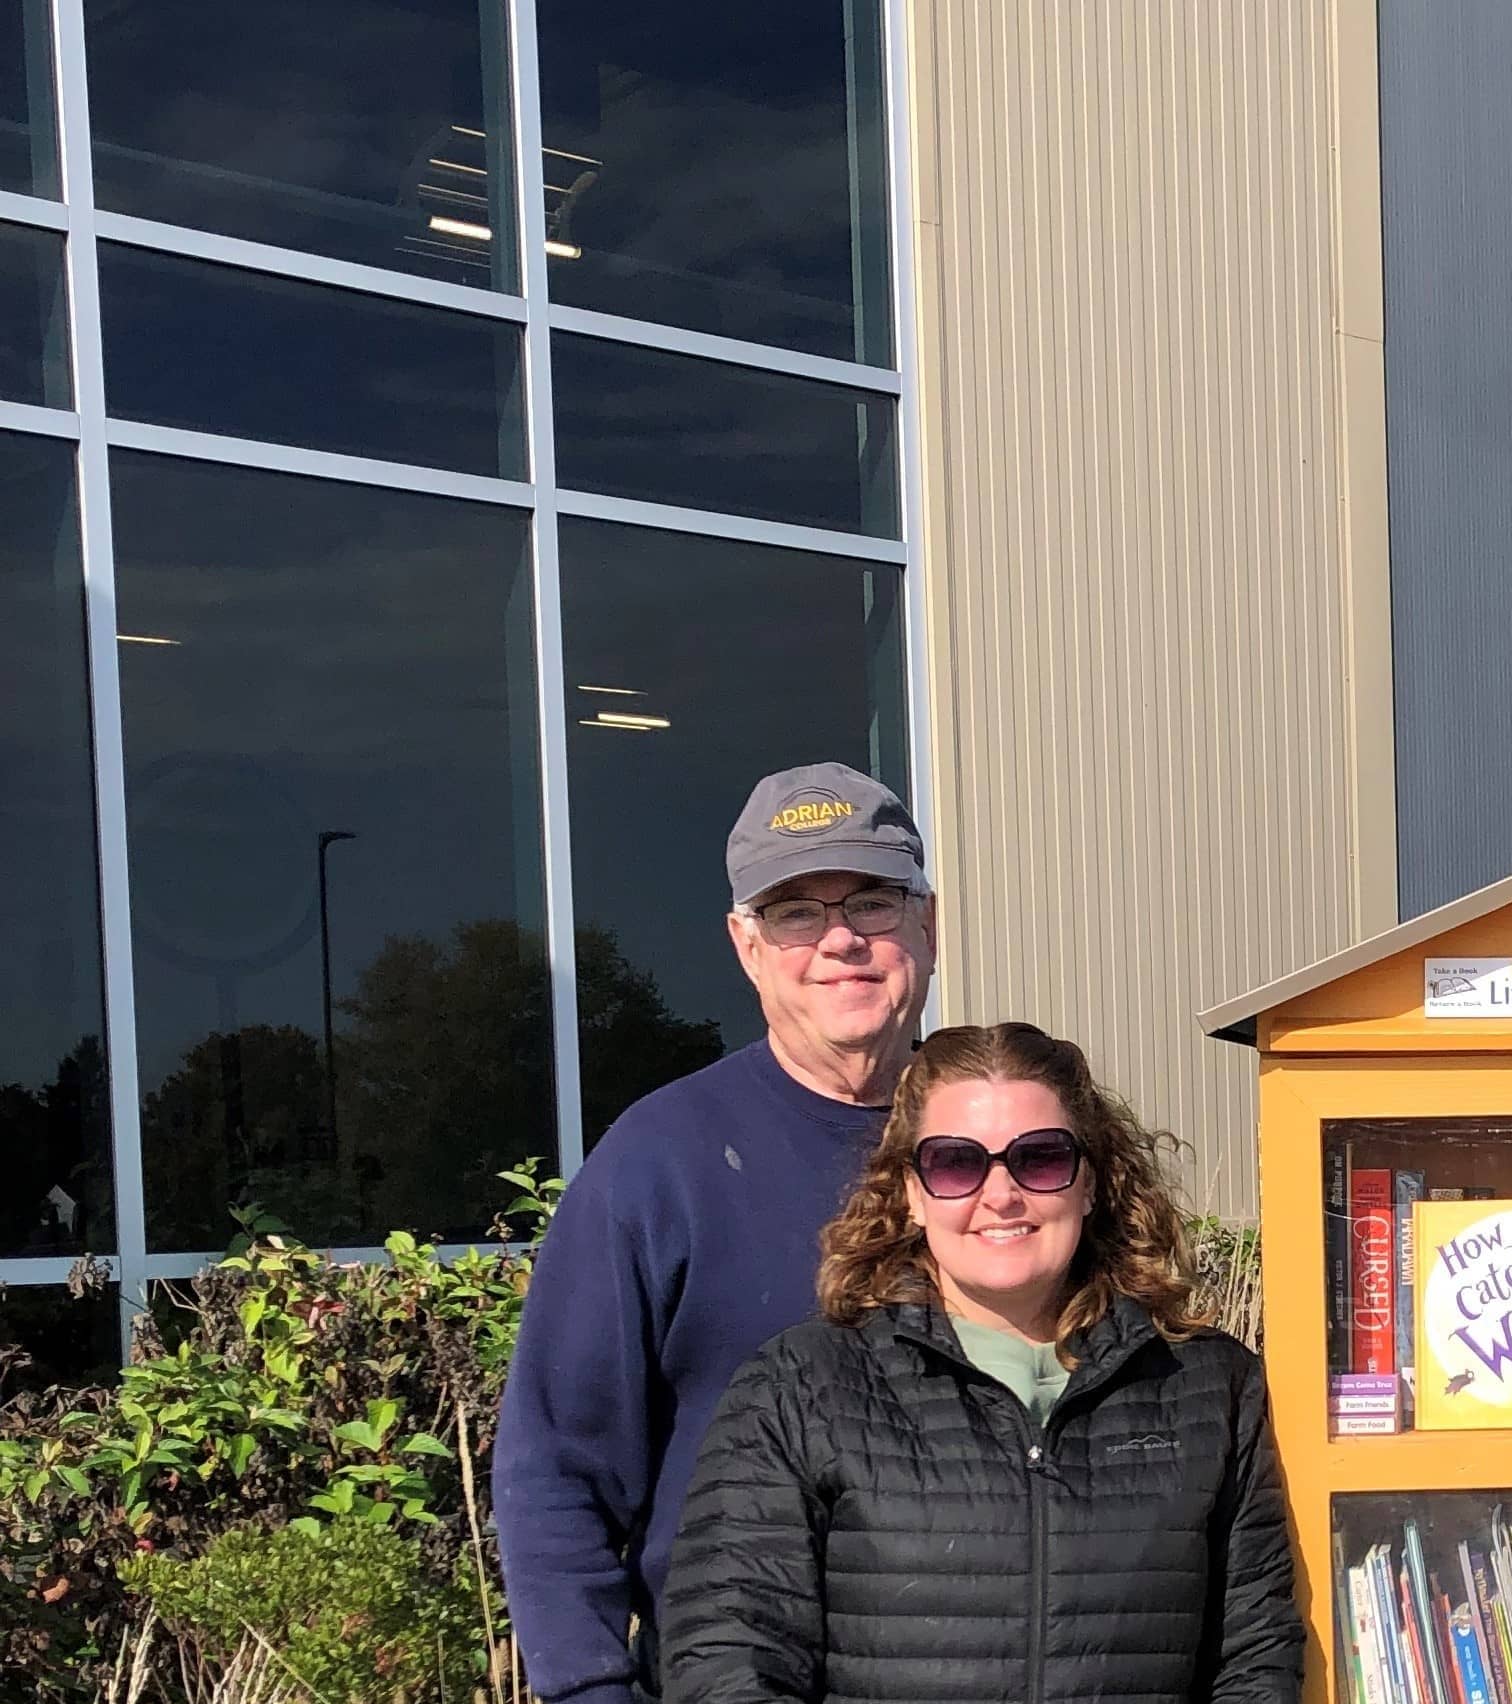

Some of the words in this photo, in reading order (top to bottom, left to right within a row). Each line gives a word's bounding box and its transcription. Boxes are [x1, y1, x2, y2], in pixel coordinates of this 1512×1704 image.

[768, 802, 853, 831] ADRIAN
[790, 819, 832, 831] COLLEGE
[1435, 1223, 1503, 1278] How
[1353, 1216, 1391, 1332] CURSED
